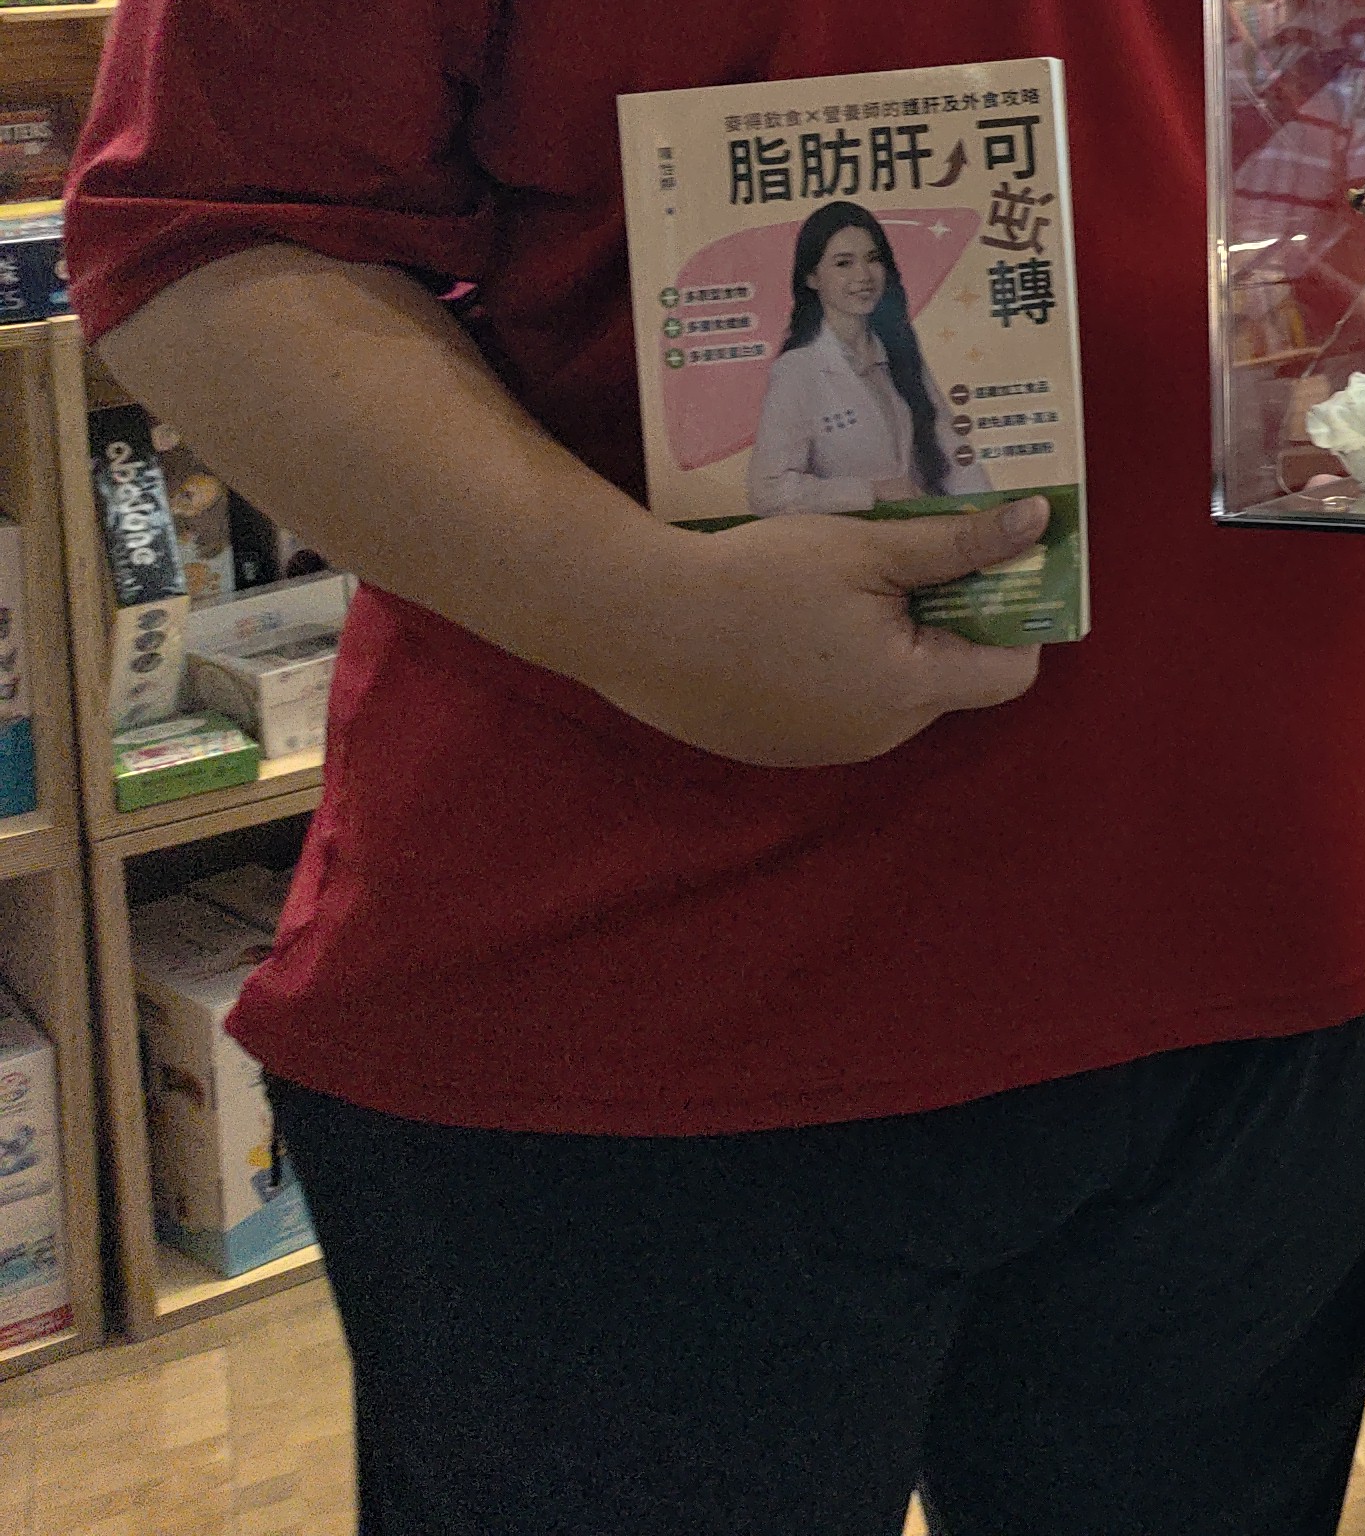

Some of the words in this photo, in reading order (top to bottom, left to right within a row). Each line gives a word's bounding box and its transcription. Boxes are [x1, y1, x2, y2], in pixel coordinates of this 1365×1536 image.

[729, 123, 933, 206] 脂肪肝
[106, 440, 155, 566] abalone
